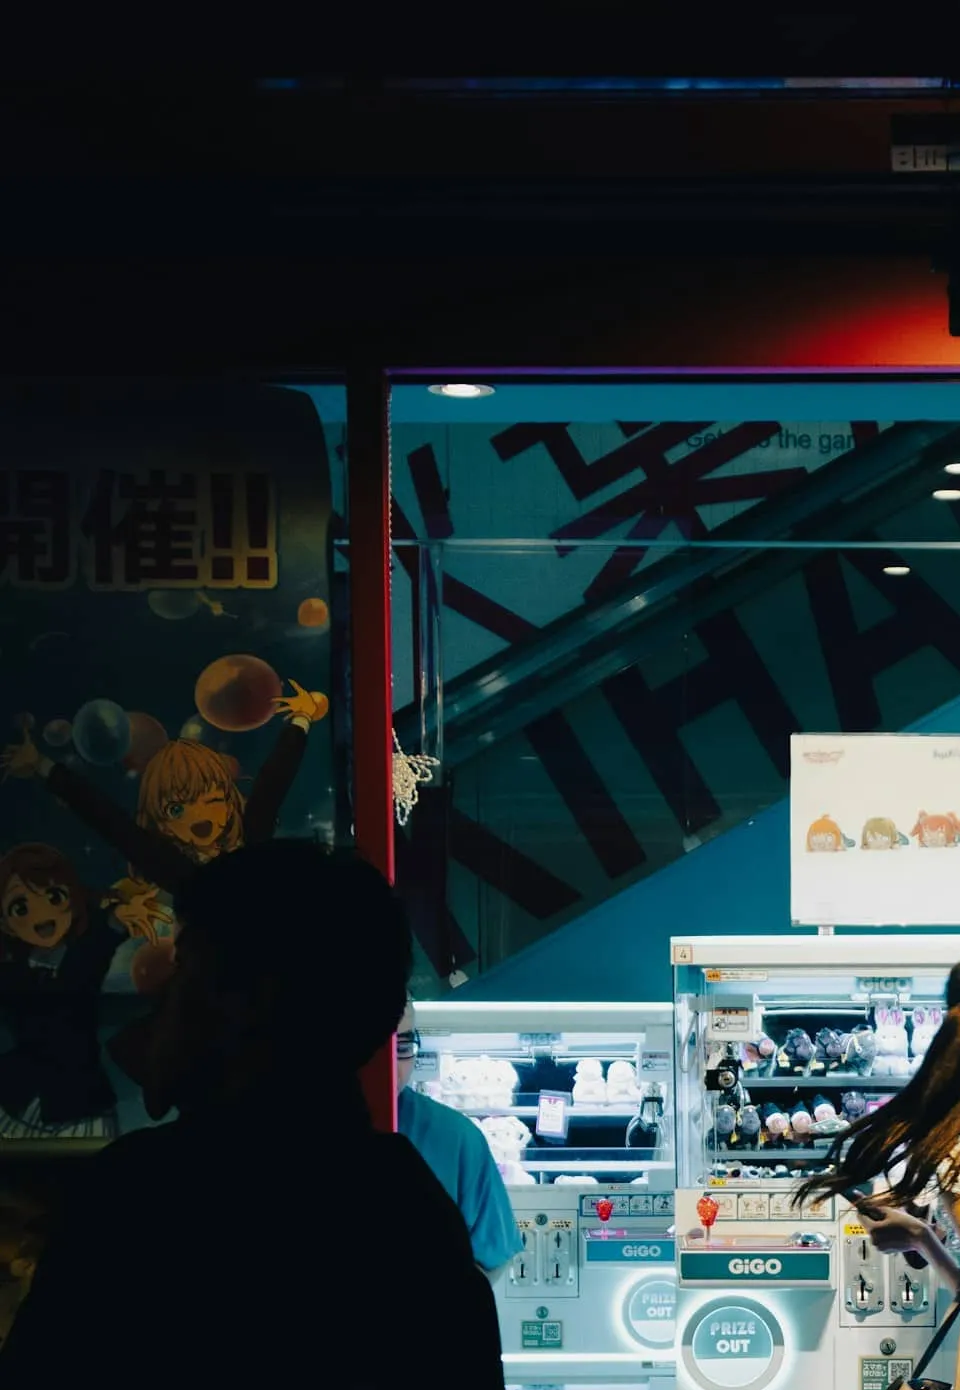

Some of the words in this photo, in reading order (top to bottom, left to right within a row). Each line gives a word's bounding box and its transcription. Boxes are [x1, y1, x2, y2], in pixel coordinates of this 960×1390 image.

[778, 428, 811, 449] the
[622, 1245, 661, 1258] GiGO
[728, 1258, 782, 1275] GiGO
[646, 1306, 672, 1318] OUT
[710, 1321, 756, 1336] PRIZE
[716, 1339, 750, 1354] OUT
